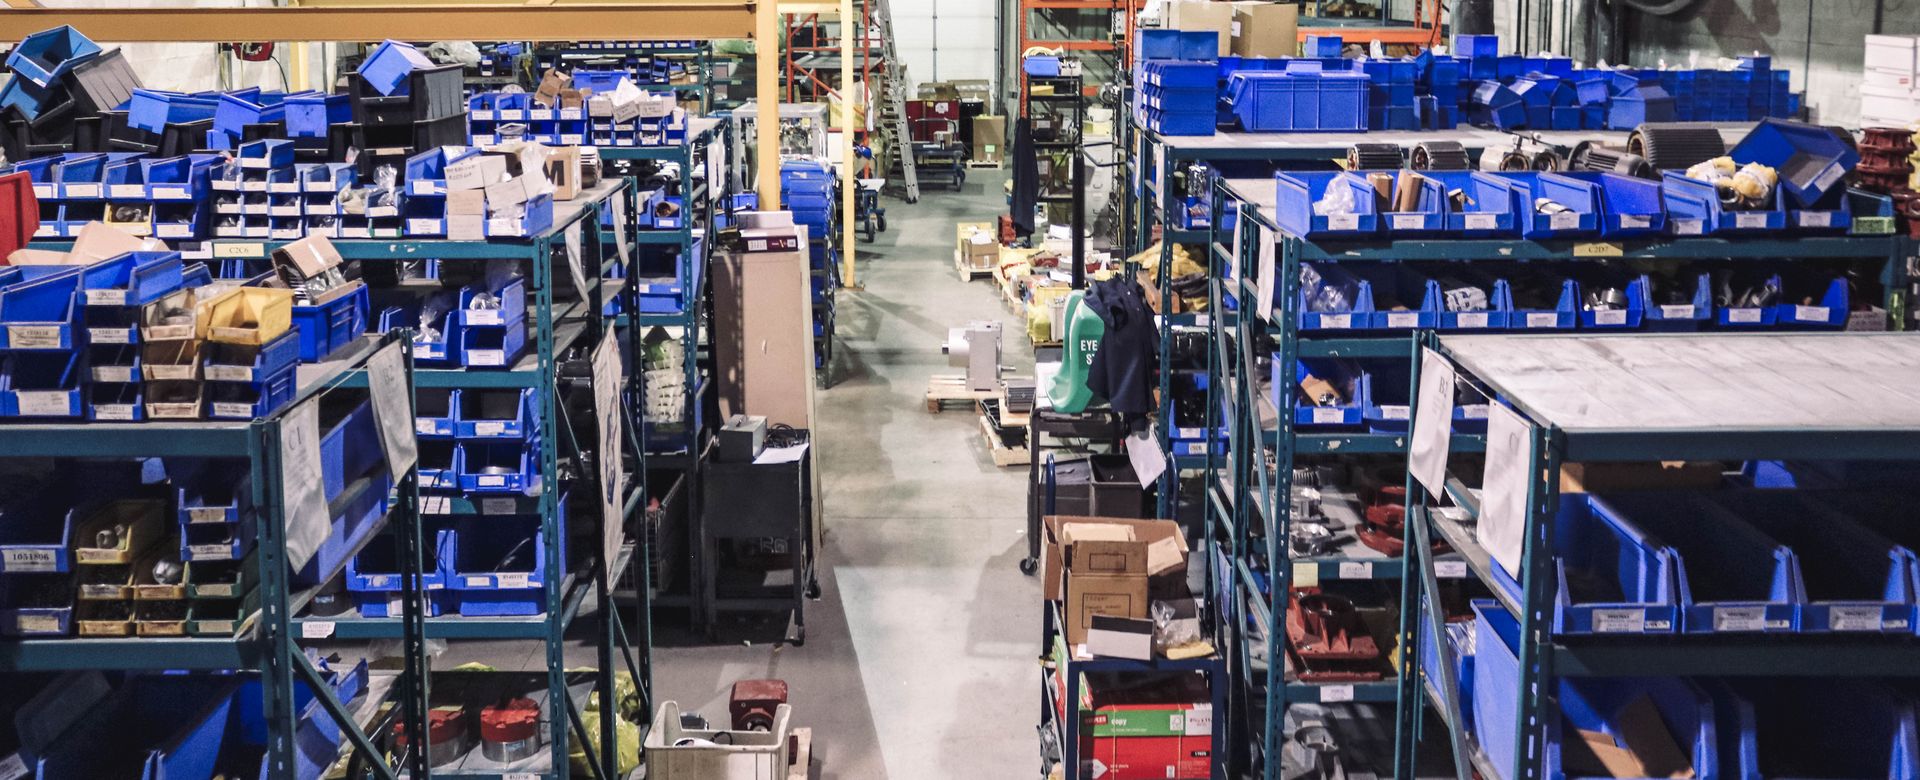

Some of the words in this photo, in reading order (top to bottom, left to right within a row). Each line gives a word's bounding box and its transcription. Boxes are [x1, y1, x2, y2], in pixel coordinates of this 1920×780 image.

[1080, 339, 1098, 352] EYE
[1086, 353, 1095, 366] S
[1111, 718, 1128, 727] copy
